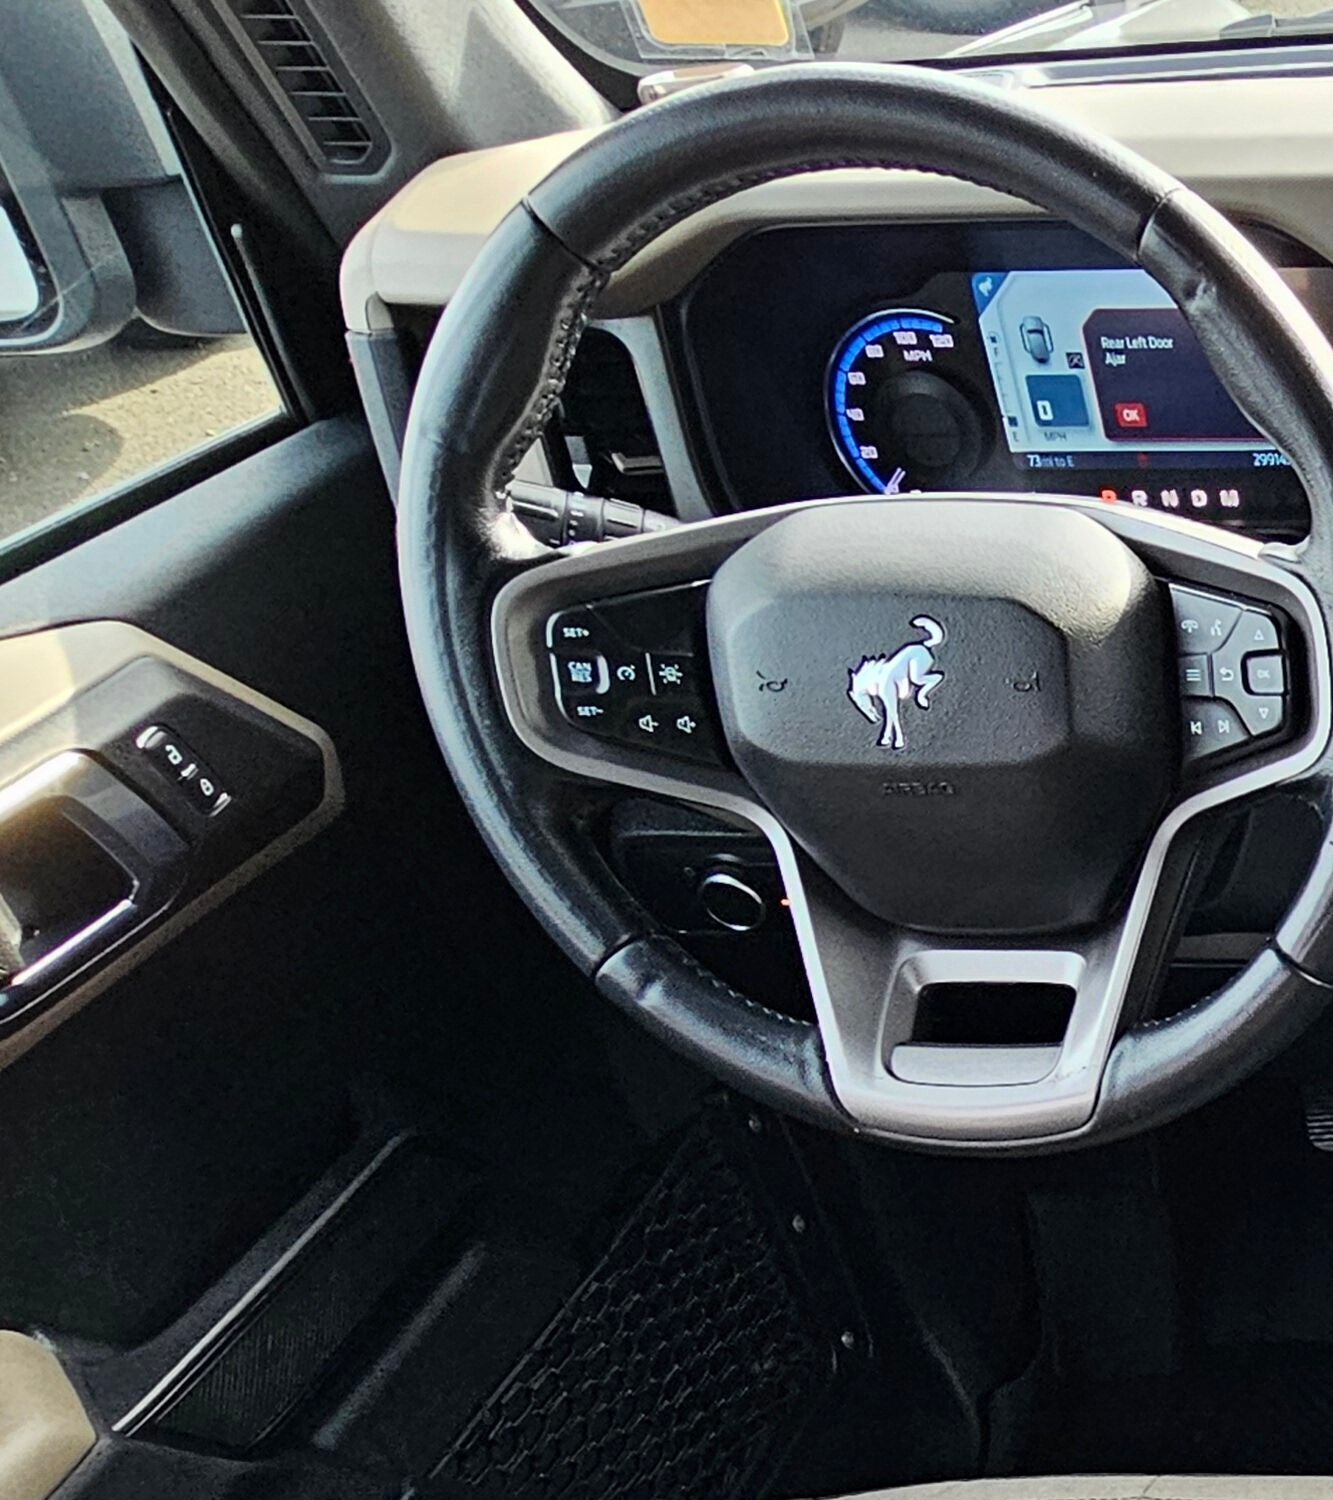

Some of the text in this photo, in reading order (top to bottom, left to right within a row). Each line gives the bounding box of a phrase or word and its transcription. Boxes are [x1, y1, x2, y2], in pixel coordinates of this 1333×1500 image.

[1101, 336, 1174, 349] Rear Left Door
[903, 350, 932, 362] MPH
[1105, 352, 1126, 367] Ajar
[1122, 407, 1140, 422] OK
[1027, 454, 1041, 468] 73
[1131, 489, 1148, 507] R
[1160, 488, 1179, 508] N
[1190, 489, 1208, 508] D
[563, 627, 590, 638] SET+
